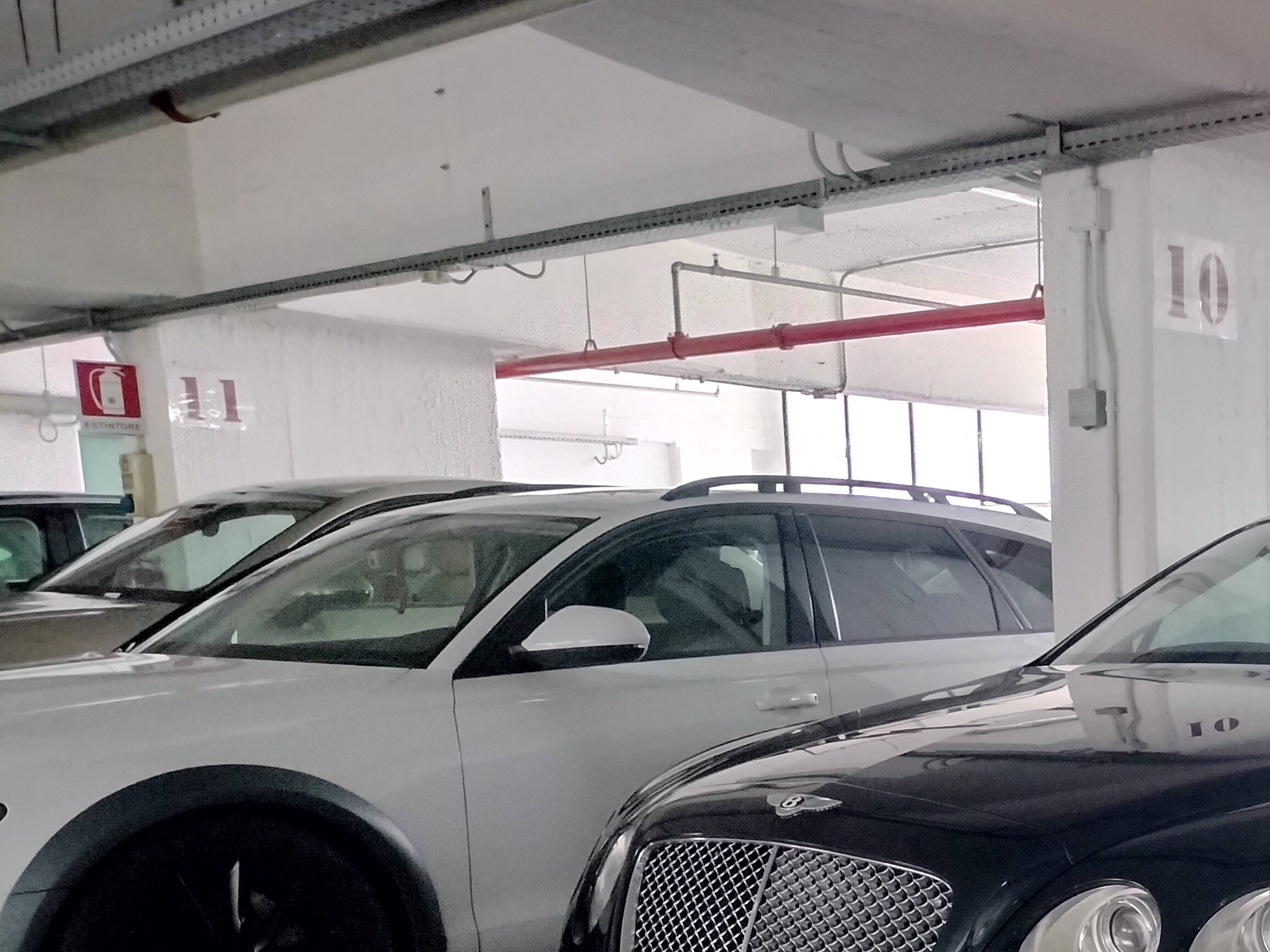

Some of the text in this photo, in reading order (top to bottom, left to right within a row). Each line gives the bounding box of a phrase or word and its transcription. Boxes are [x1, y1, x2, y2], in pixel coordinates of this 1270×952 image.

[1167, 245, 1229, 326] 10
[180, 377, 242, 423] 11
[84, 421, 141, 431] ESTINTORE
